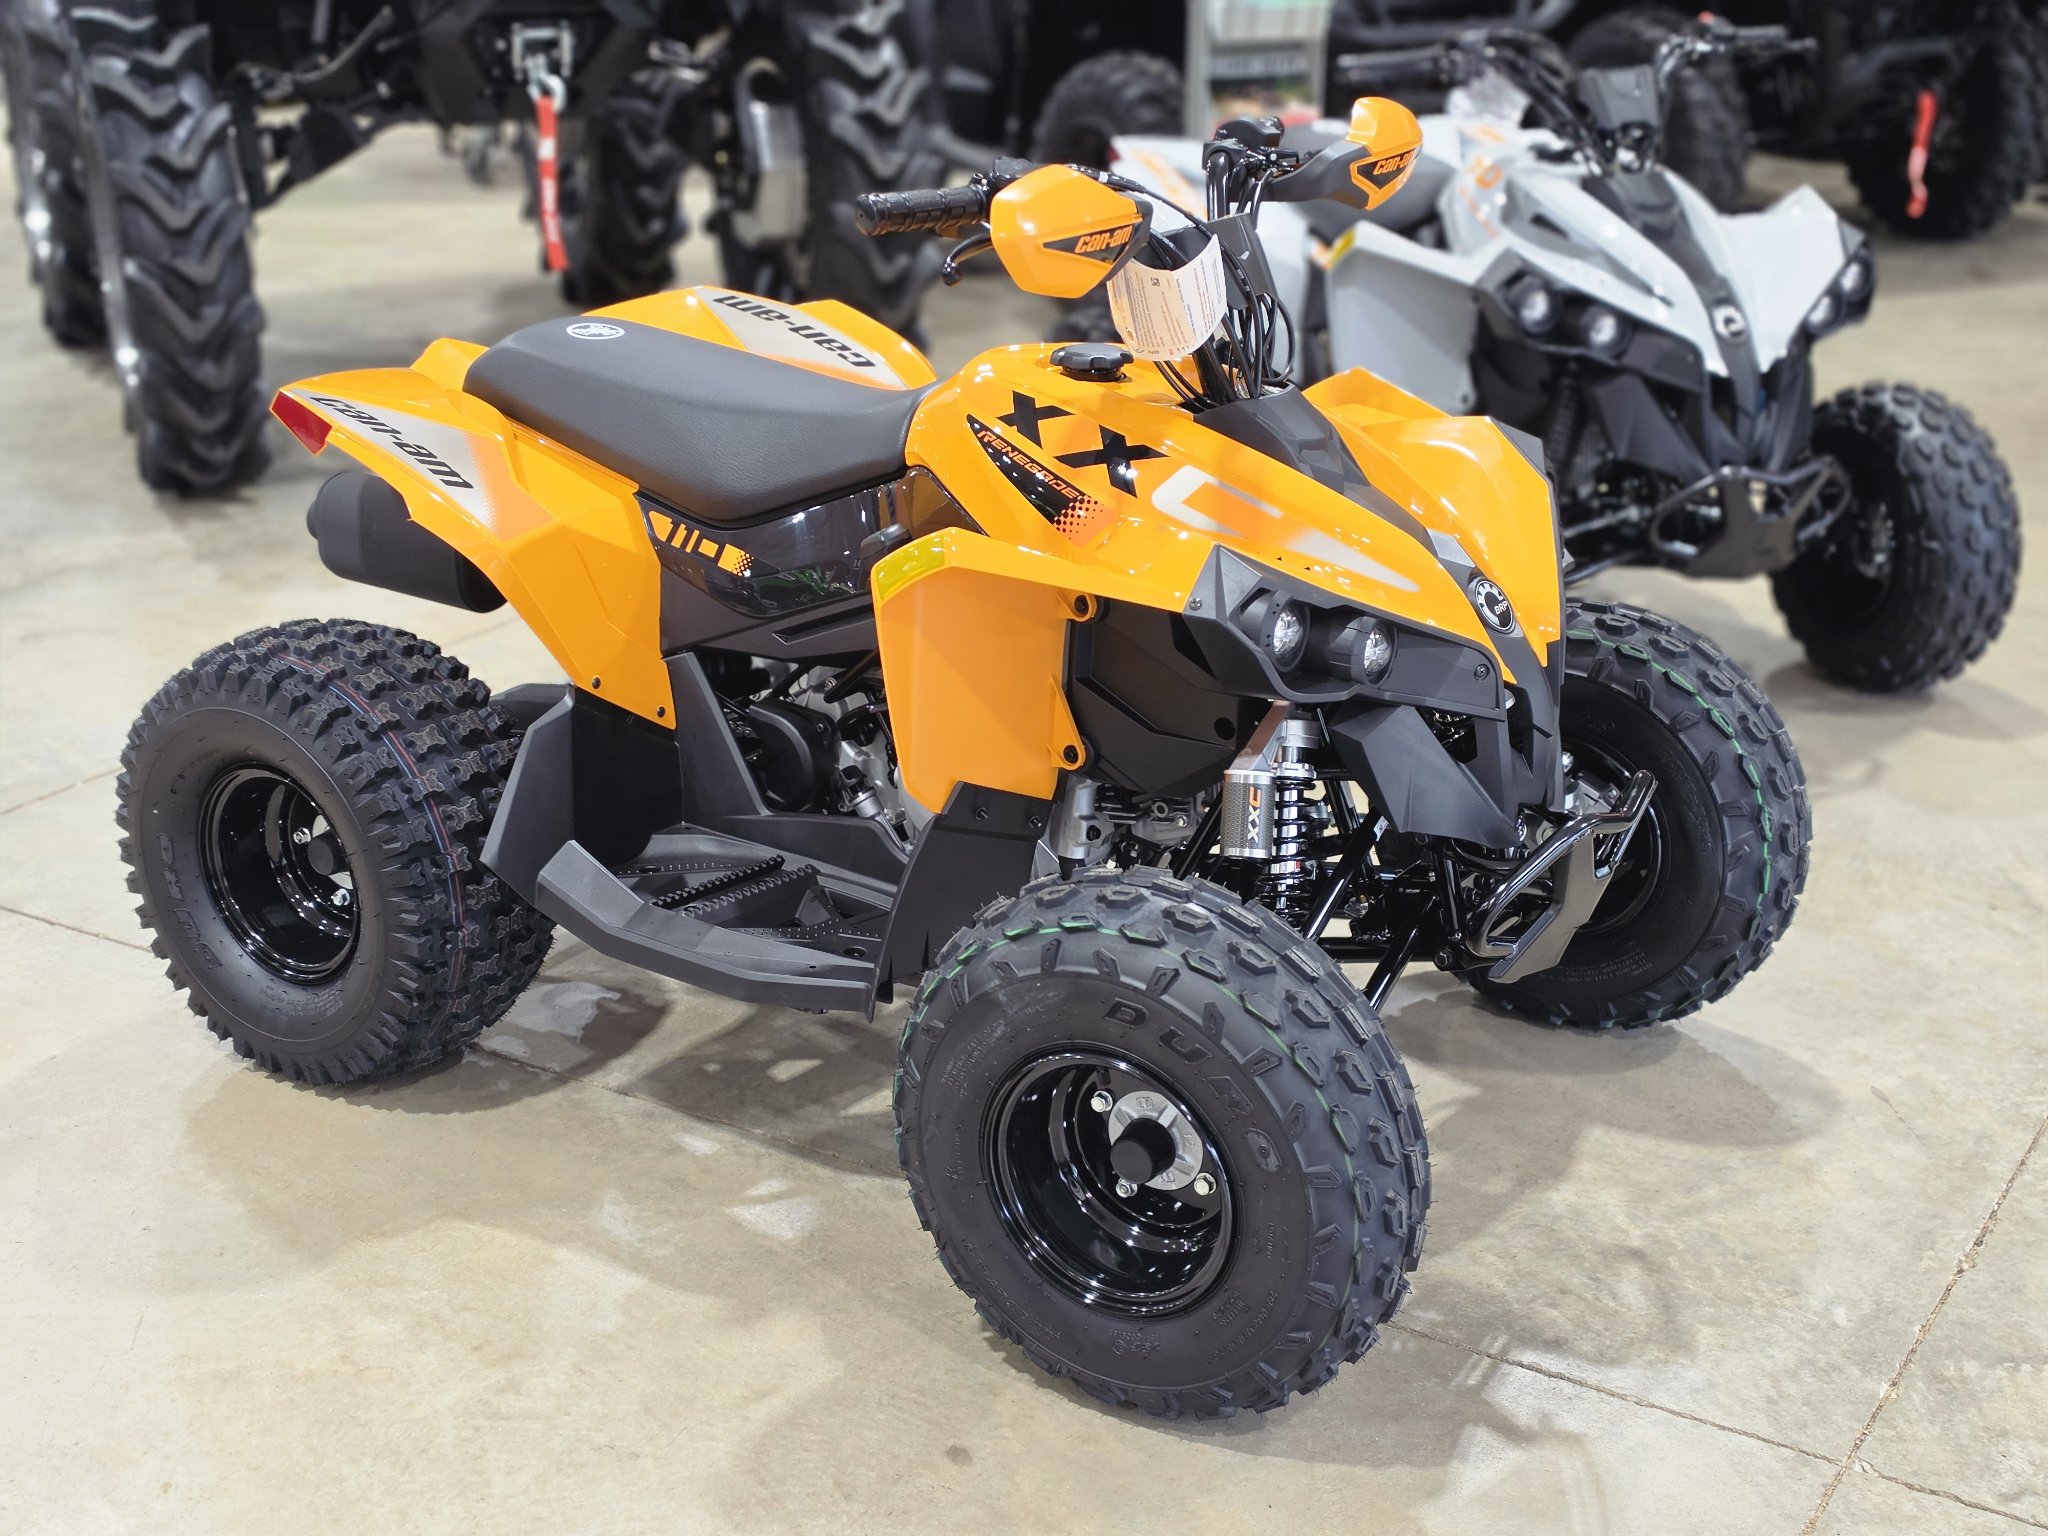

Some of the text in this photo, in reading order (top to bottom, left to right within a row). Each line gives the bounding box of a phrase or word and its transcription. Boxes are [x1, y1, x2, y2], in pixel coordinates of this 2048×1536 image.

[1074, 225, 1133, 254] can-am
[713, 295, 876, 367] can-am
[309, 396, 474, 489] can-am
[976, 430, 1080, 499] RENEGADE
[1494, 600, 1508, 615] BRP
[1247, 786, 1262, 844] XXC
[1104, 997, 1283, 1172] DURO
